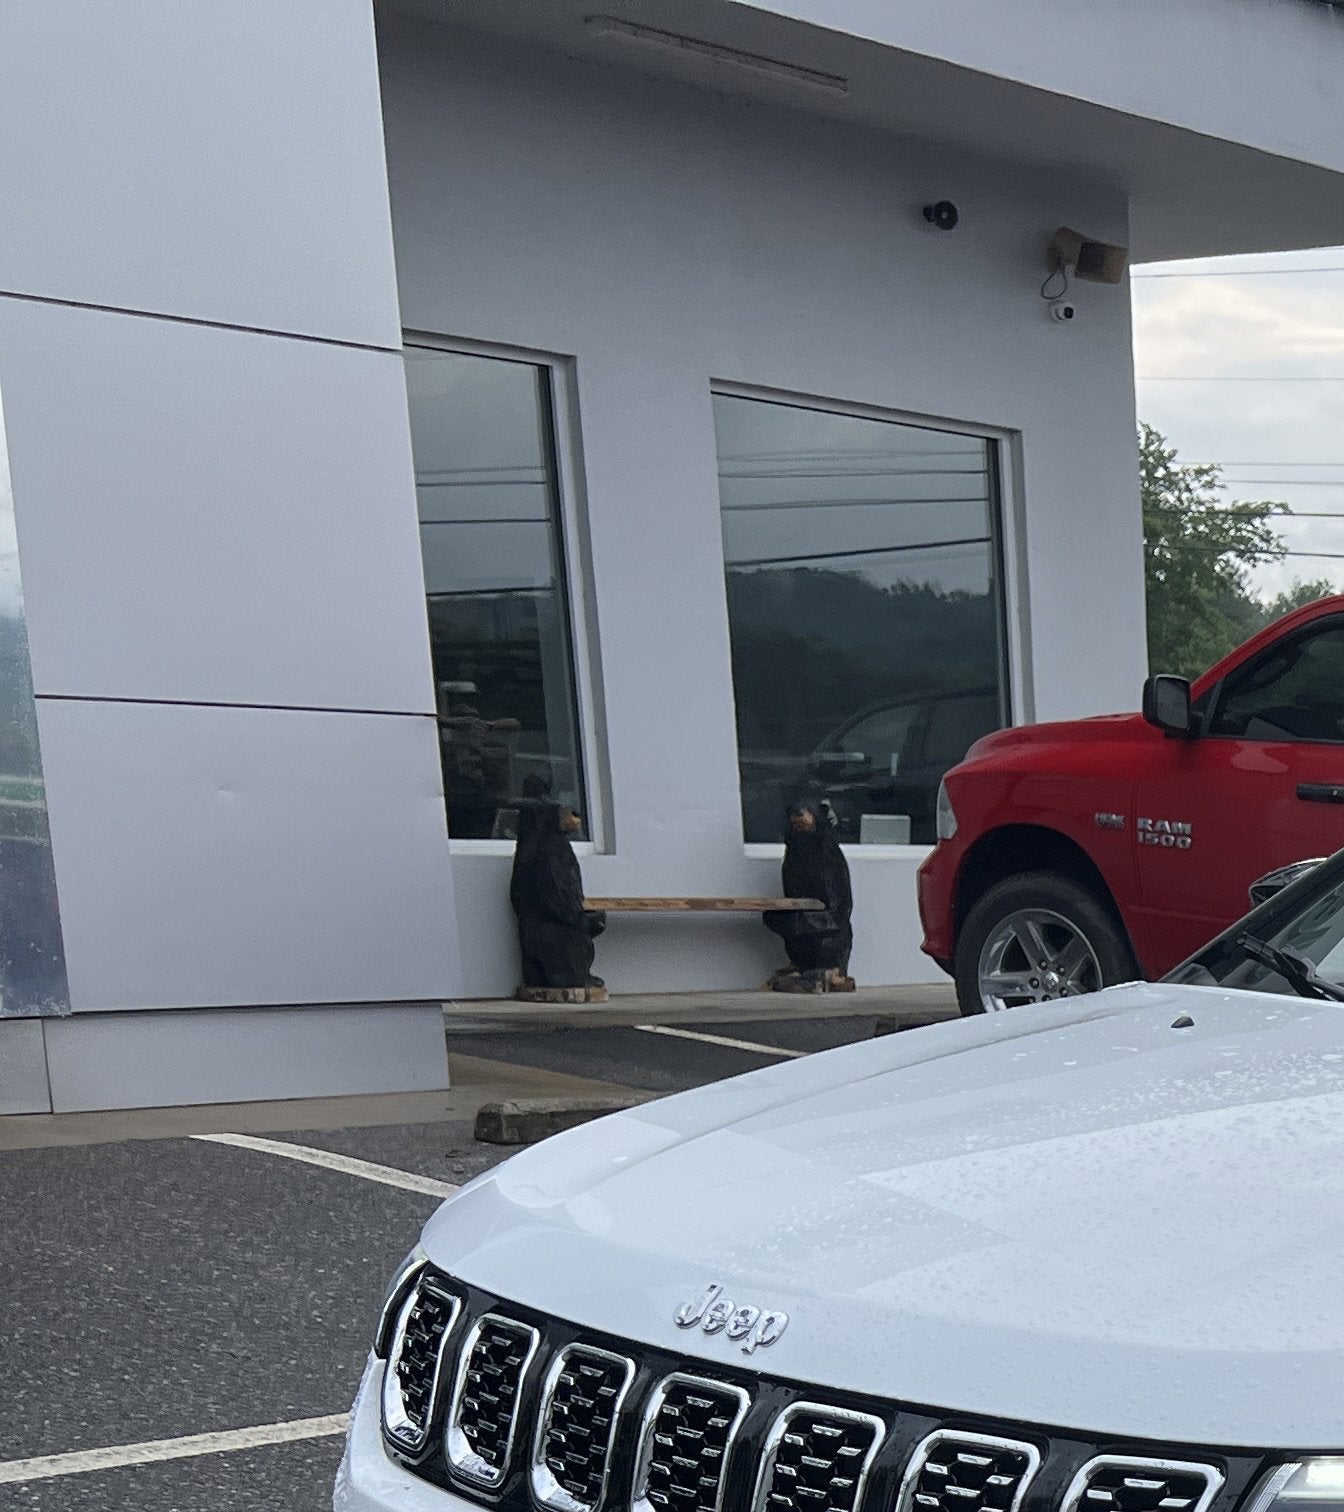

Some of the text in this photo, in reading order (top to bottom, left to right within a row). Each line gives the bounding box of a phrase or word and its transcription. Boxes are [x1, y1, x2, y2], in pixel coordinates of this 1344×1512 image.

[1137, 816, 1193, 835] RAM
[1137, 831, 1192, 849] 1500
[672, 1284, 790, 1354] Jeep
